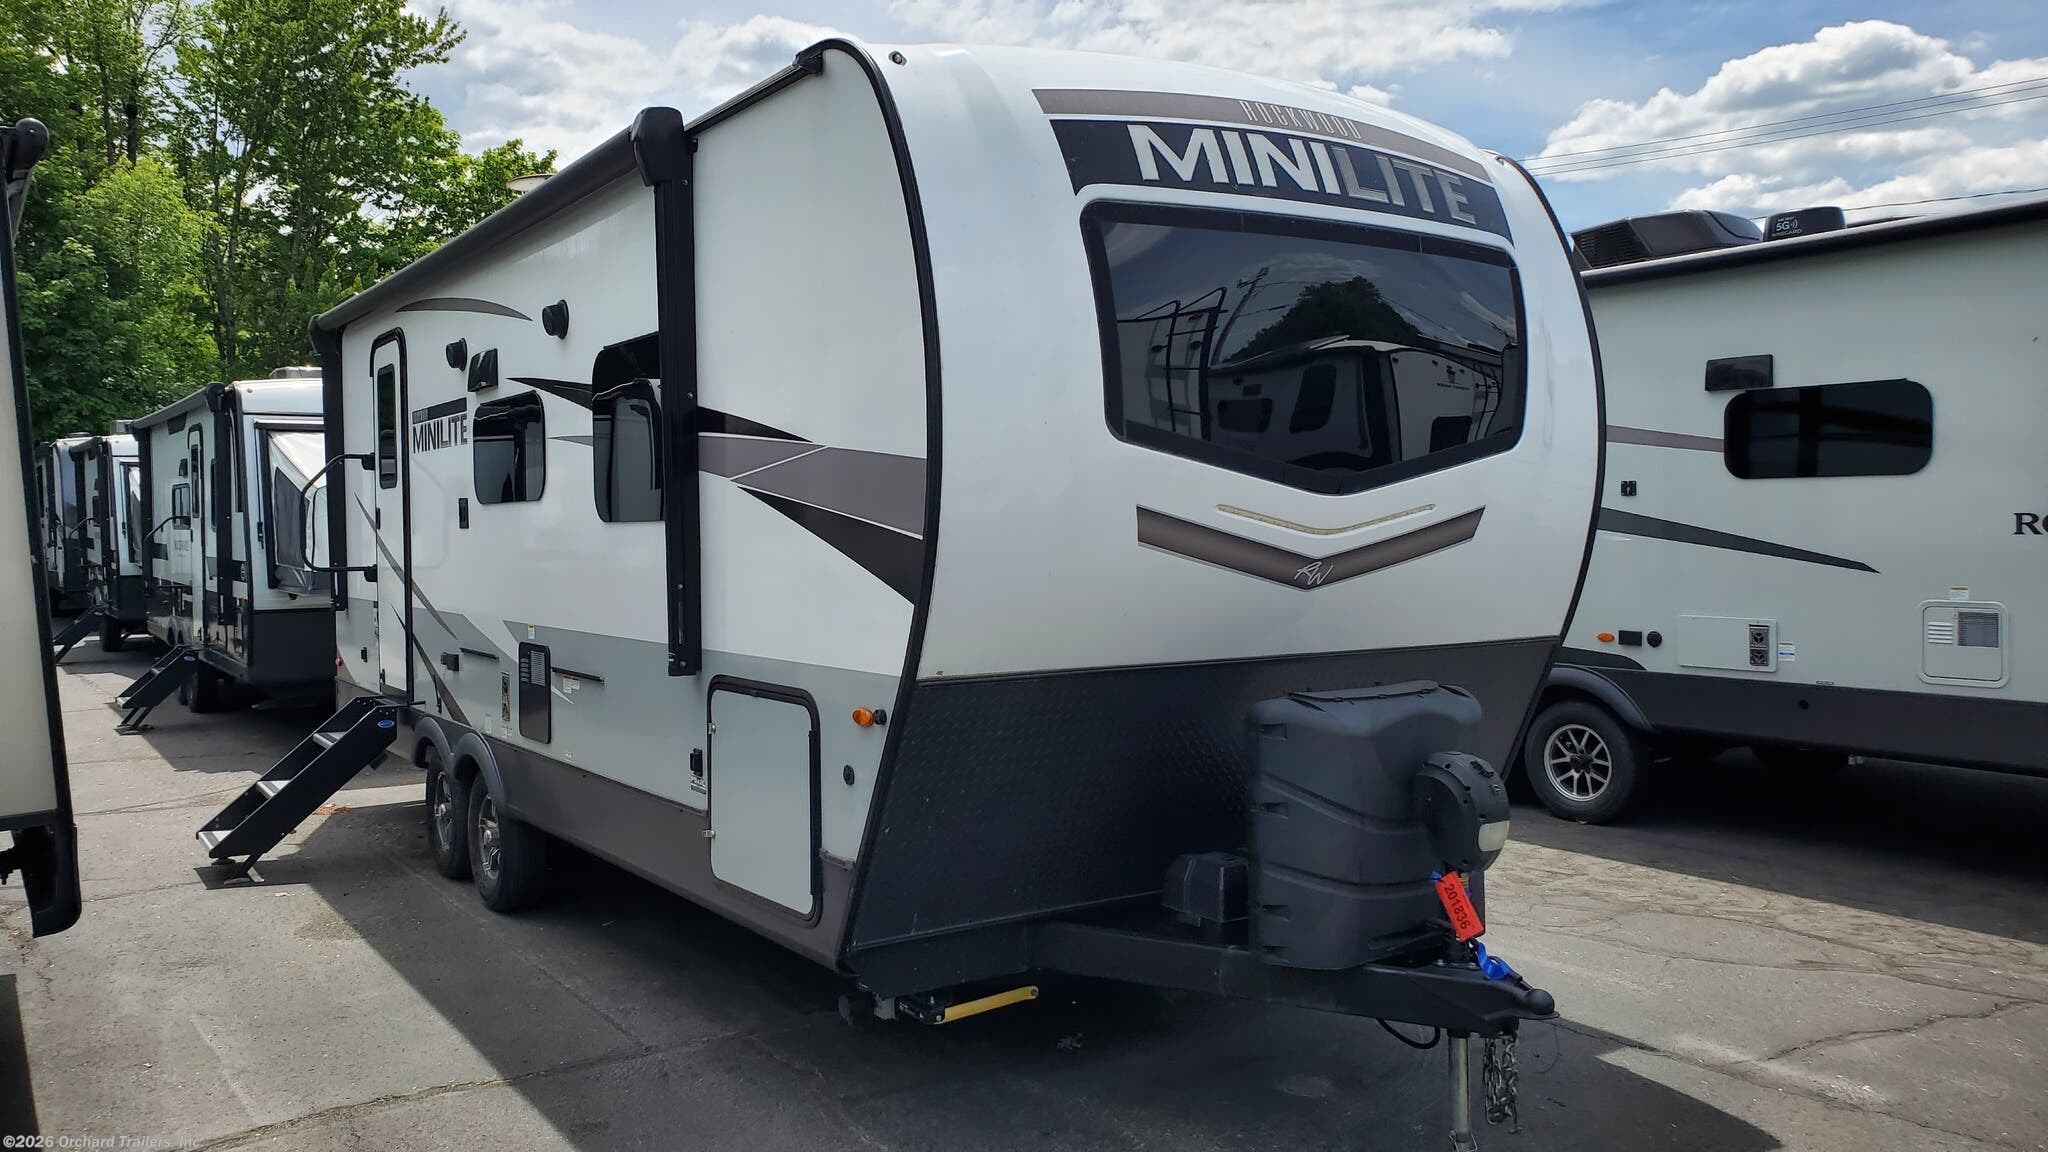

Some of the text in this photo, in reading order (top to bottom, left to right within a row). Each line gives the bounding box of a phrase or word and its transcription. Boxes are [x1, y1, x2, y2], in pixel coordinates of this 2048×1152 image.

[1239, 100, 1362, 139] ROCKWOOD
[1127, 124, 1477, 225] MINILITE
[1776, 221, 1790, 231] 5G
[412, 413, 468, 454] MINILITE
[2013, 512, 2048, 535] R
[1444, 883, 1471, 930] 201836
